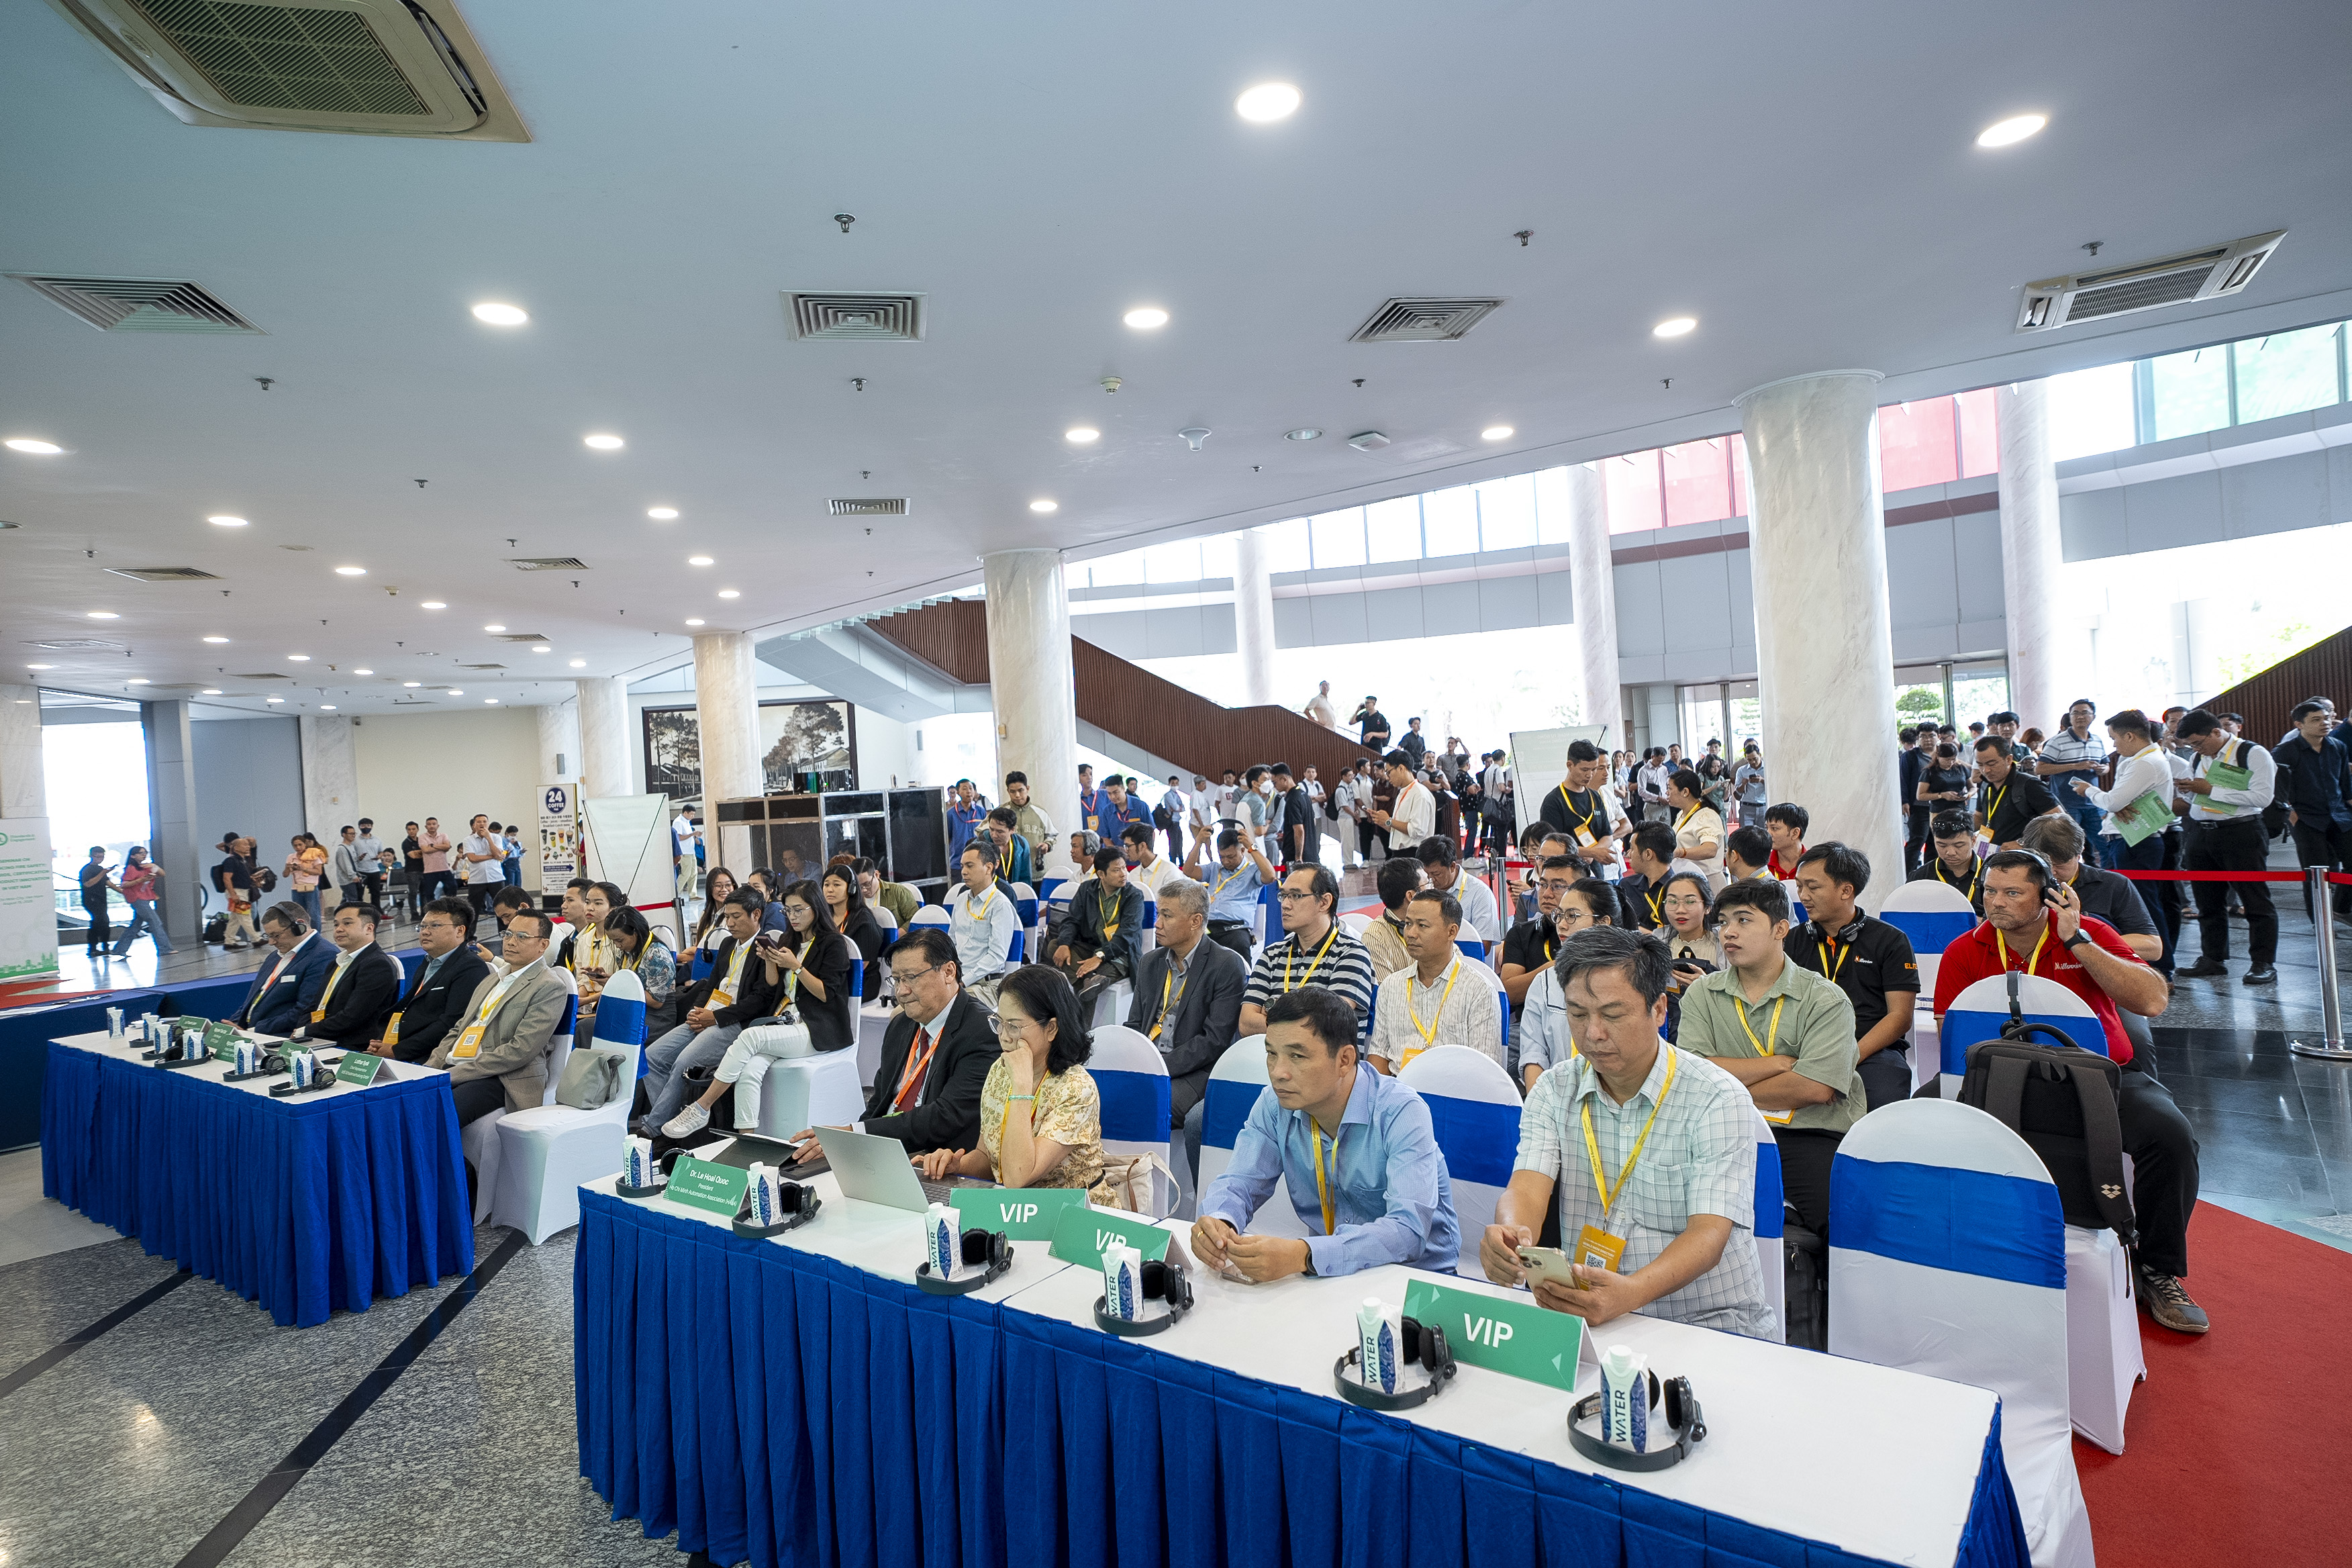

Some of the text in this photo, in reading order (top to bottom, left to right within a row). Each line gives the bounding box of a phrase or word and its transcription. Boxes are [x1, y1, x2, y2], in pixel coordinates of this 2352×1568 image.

[548, 791, 562, 802] 24
[697, 1171, 703, 1179] Le
[703, 1173, 716, 1182] Hoai
[715, 1175, 729, 1185] Quoc
[697, 1183, 714, 1191] President
[688, 1189, 707, 1199] Automation
[706, 1193, 726, 1203] Association
[999, 1204, 1038, 1223] VIP
[930, 1232, 938, 1268] WATER
[1096, 1228, 1127, 1251] VIP
[1109, 1276, 1118, 1317] WATER
[1464, 1312, 1514, 1349] VIP
[1367, 1336, 1377, 1383] WATER
[1615, 1389, 1626, 1442] WATER
